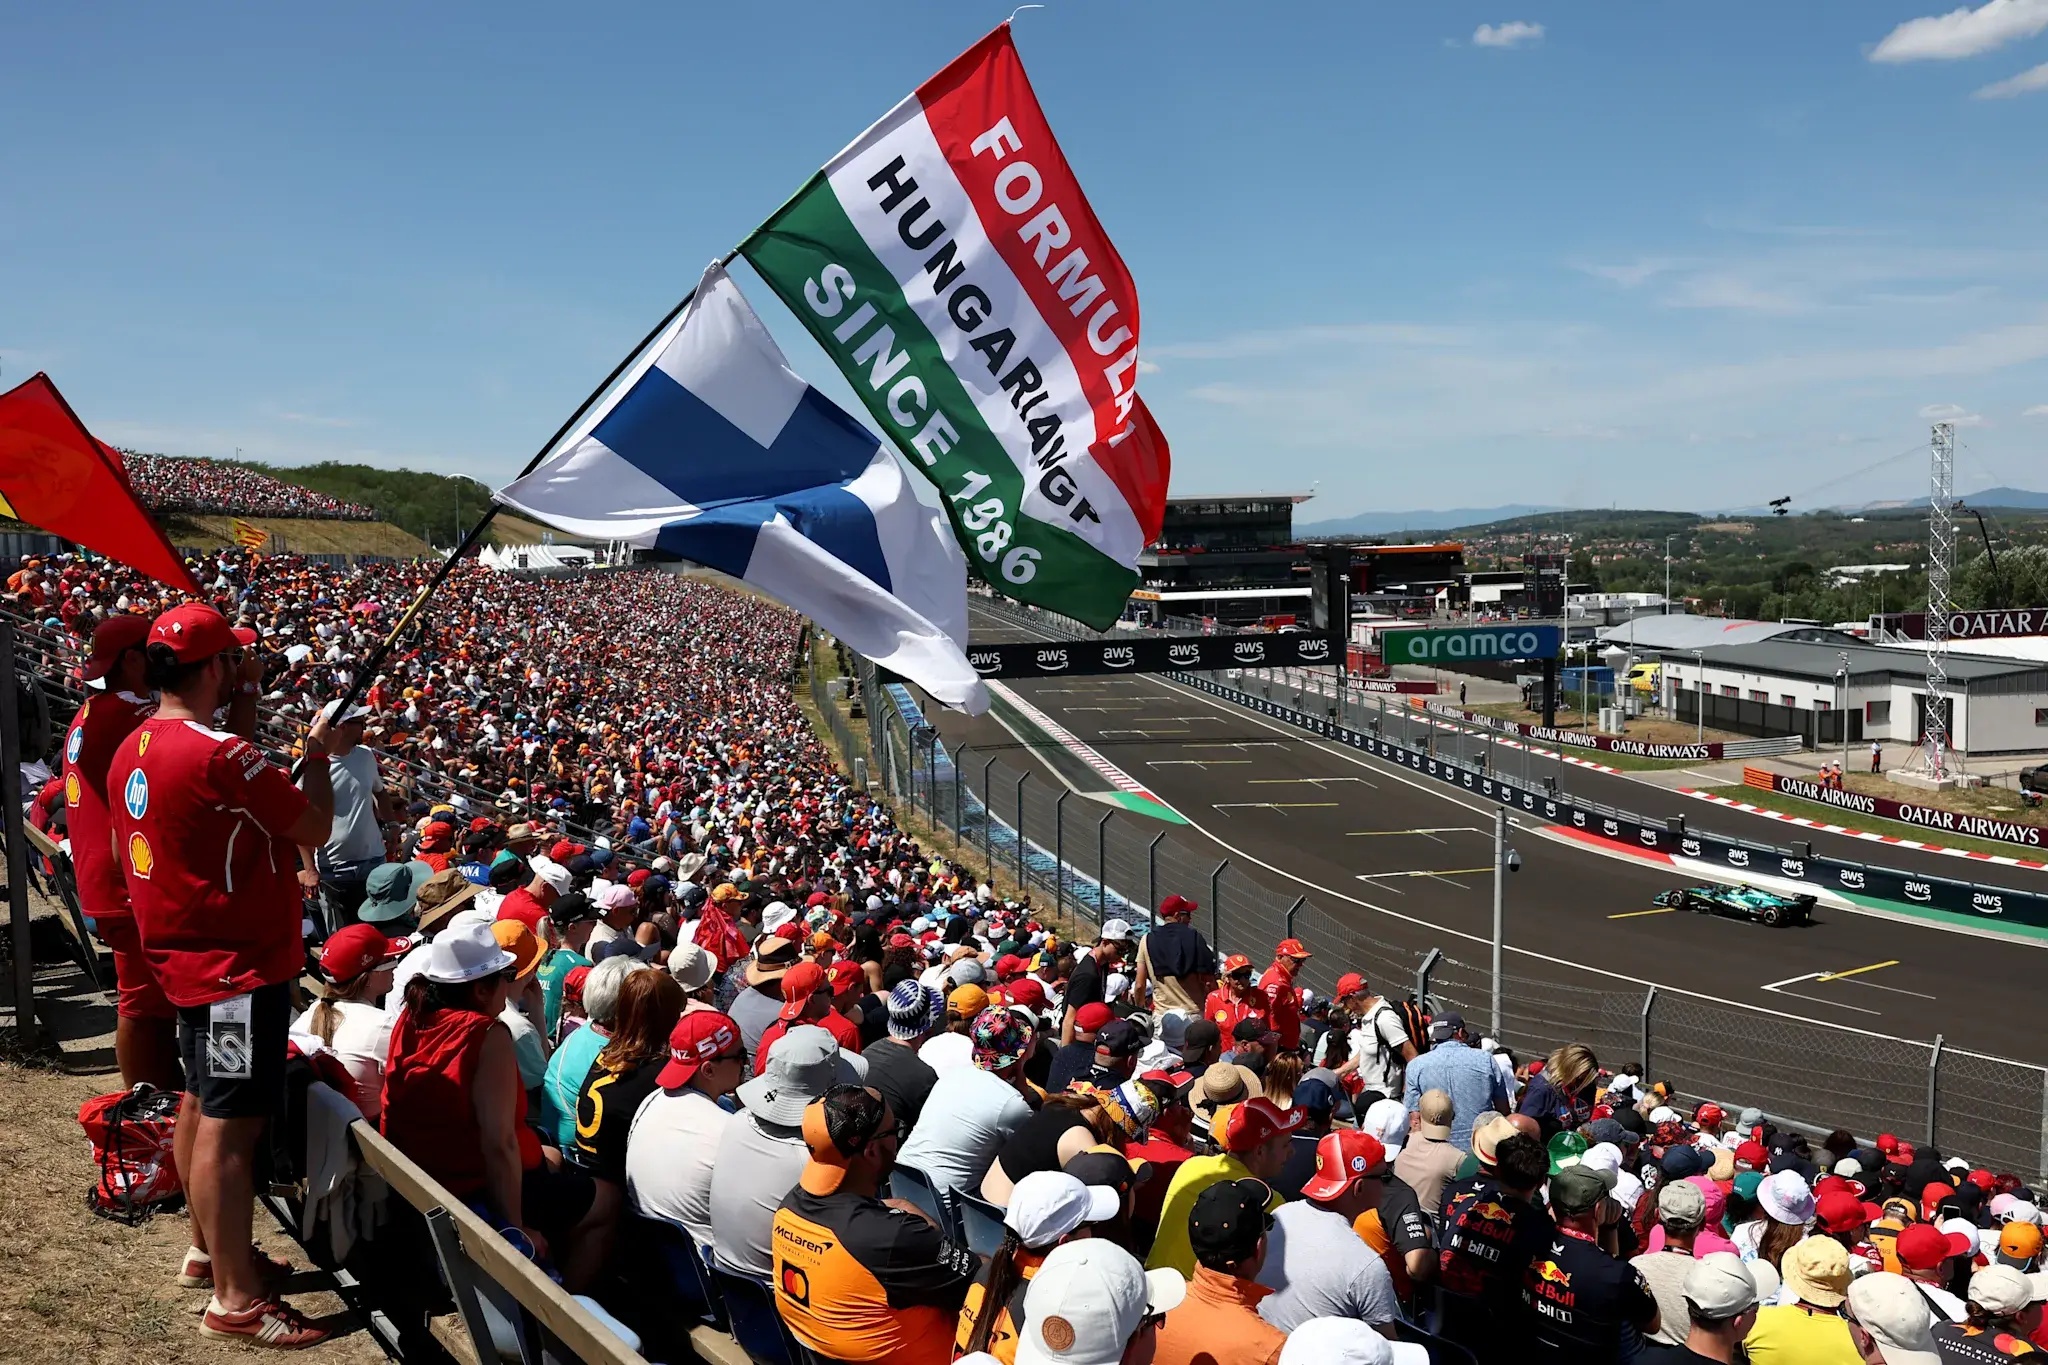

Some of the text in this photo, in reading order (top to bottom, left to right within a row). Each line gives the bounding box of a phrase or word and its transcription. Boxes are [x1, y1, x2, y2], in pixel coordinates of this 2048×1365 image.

[804, 263, 1042, 584] SINCE 1986
[1950, 612, 2032, 637] QATAR
[1169, 643, 1199, 656] aws
[1234, 641, 1264, 654] aws
[1299, 639, 1328, 651] aws
[1408, 632, 1538, 658] aramco
[970, 652, 1001, 665] aws
[1037, 649, 1068, 662] aws
[1103, 646, 1134, 659] aws
[1364, 681, 1397, 692] AIRWAYS
[1472, 714, 1491, 728] QATAR
[1530, 725, 1597, 748] QATAR AIRWAYS
[1611, 740, 1709, 758] QATAR AIRWAYS
[128, 771, 146, 818] hp
[1781, 777, 1874, 813] QATAR AIRWAYS
[1573, 811, 1585, 820] aws
[1604, 819, 1618, 830] aws
[1899, 804, 2040, 845] QATAR AIRWAYS
[1640, 828, 1657, 840] aws
[1682, 839, 1700, 850] aws
[1728, 848, 1749, 860] aws
[1782, 858, 1804, 871] aws
[1840, 869, 1864, 883] aws
[1905, 881, 1930, 895] aws
[1973, 893, 2001, 907] aws
[696, 1026, 733, 1058] 55
[775, 1226, 823, 1255] McLaren
[1546, 1284, 1575, 1307] Bull
